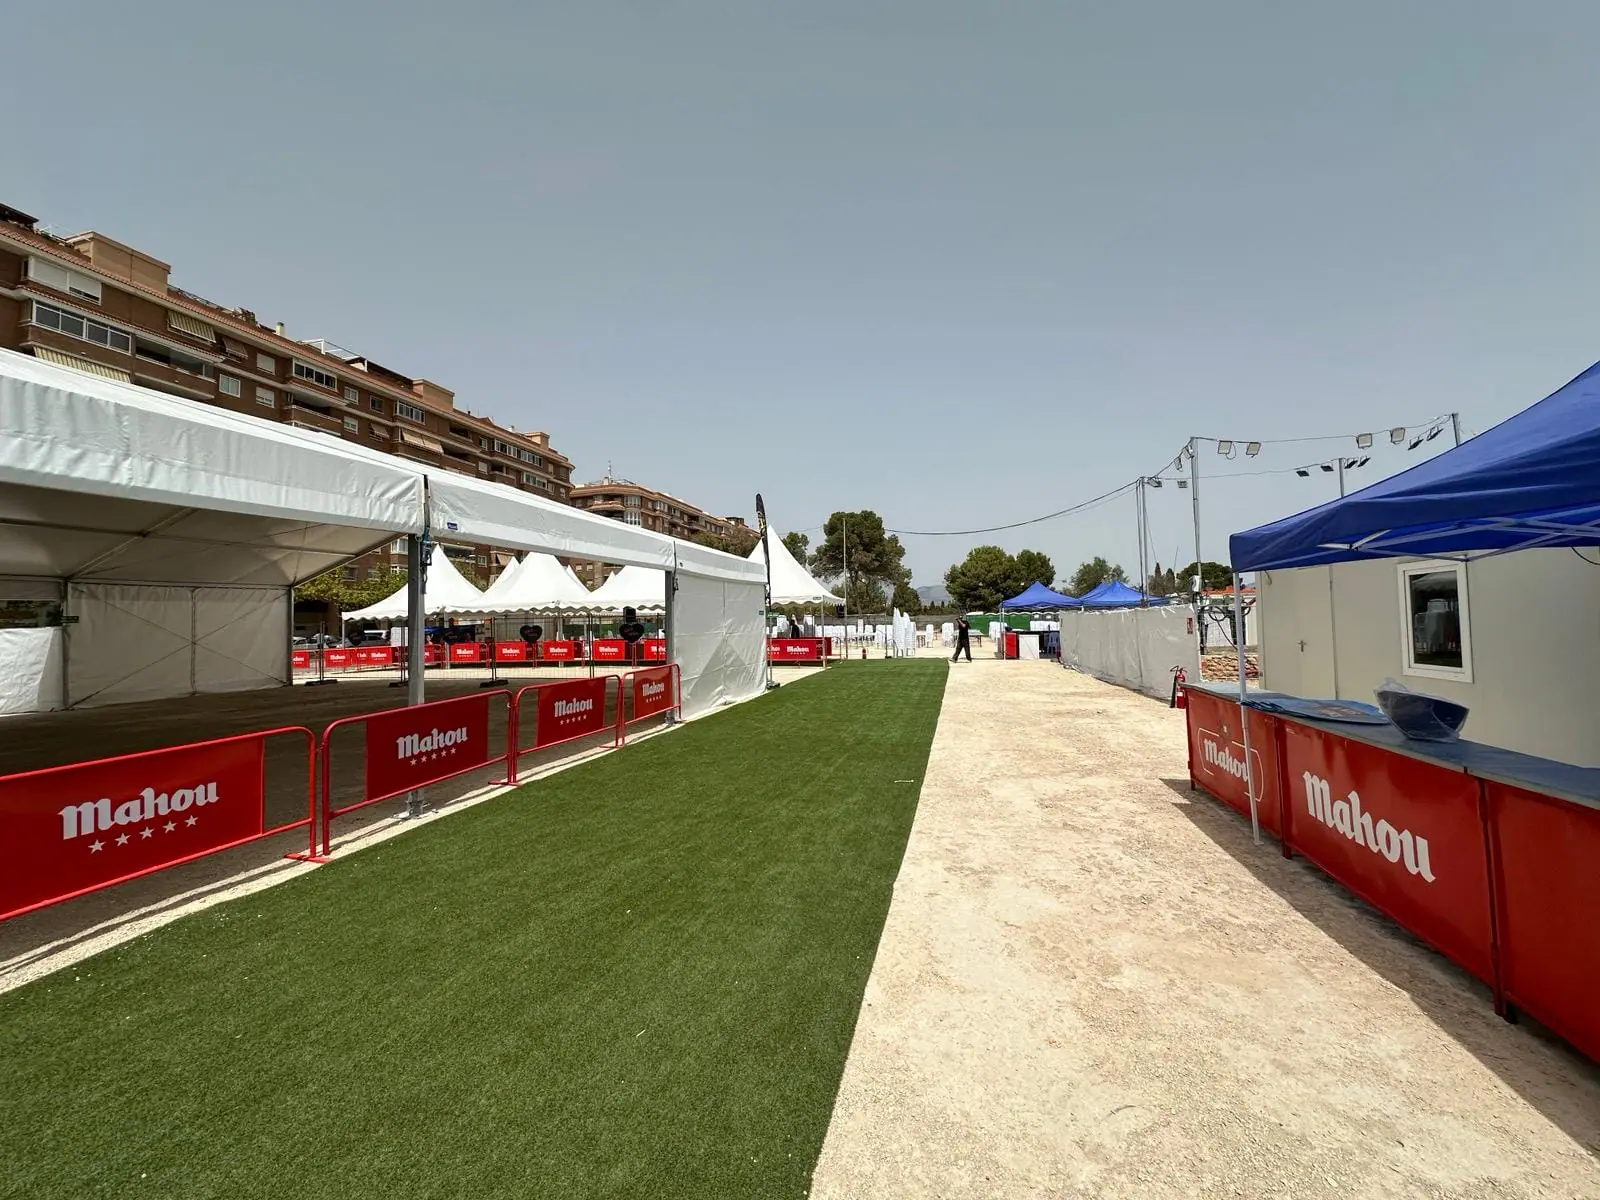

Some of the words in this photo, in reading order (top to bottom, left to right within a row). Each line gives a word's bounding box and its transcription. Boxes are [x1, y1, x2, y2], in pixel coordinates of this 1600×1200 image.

[642, 682, 664, 697] Mahou
[554, 698, 593, 718] Mahou
[396, 726, 468, 760] Mahou
[58, 781, 220, 840] Mahou
[1302, 770, 1436, 883] Mahou
